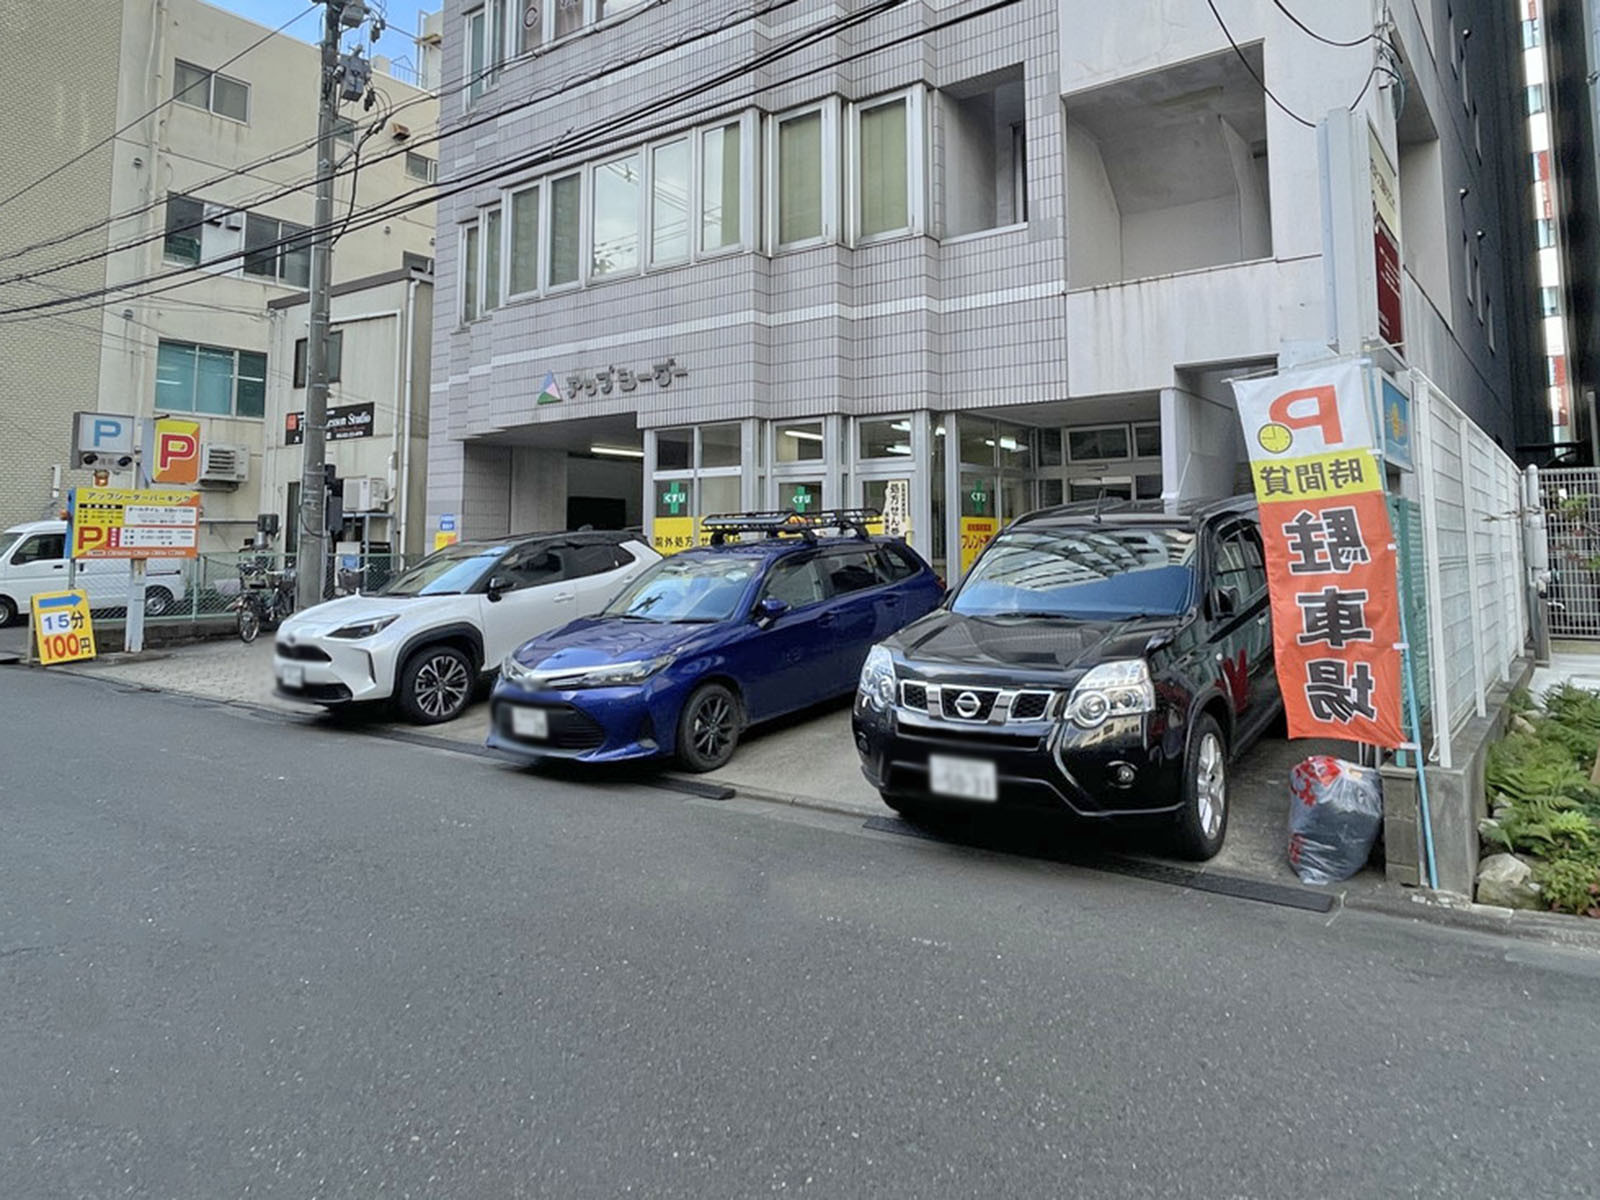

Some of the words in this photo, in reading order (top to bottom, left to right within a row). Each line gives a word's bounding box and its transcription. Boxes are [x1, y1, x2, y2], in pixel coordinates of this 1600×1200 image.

[566, 358, 689, 399] アップシーダー
[93, 419, 122, 448] P
[159, 432, 196, 470] P
[664, 492, 686, 503] くすり
[792, 494, 812, 503] くすり
[78, 527, 103, 550] P
[44, 611, 84, 630] 15分
[44, 633, 92, 660] 100円
